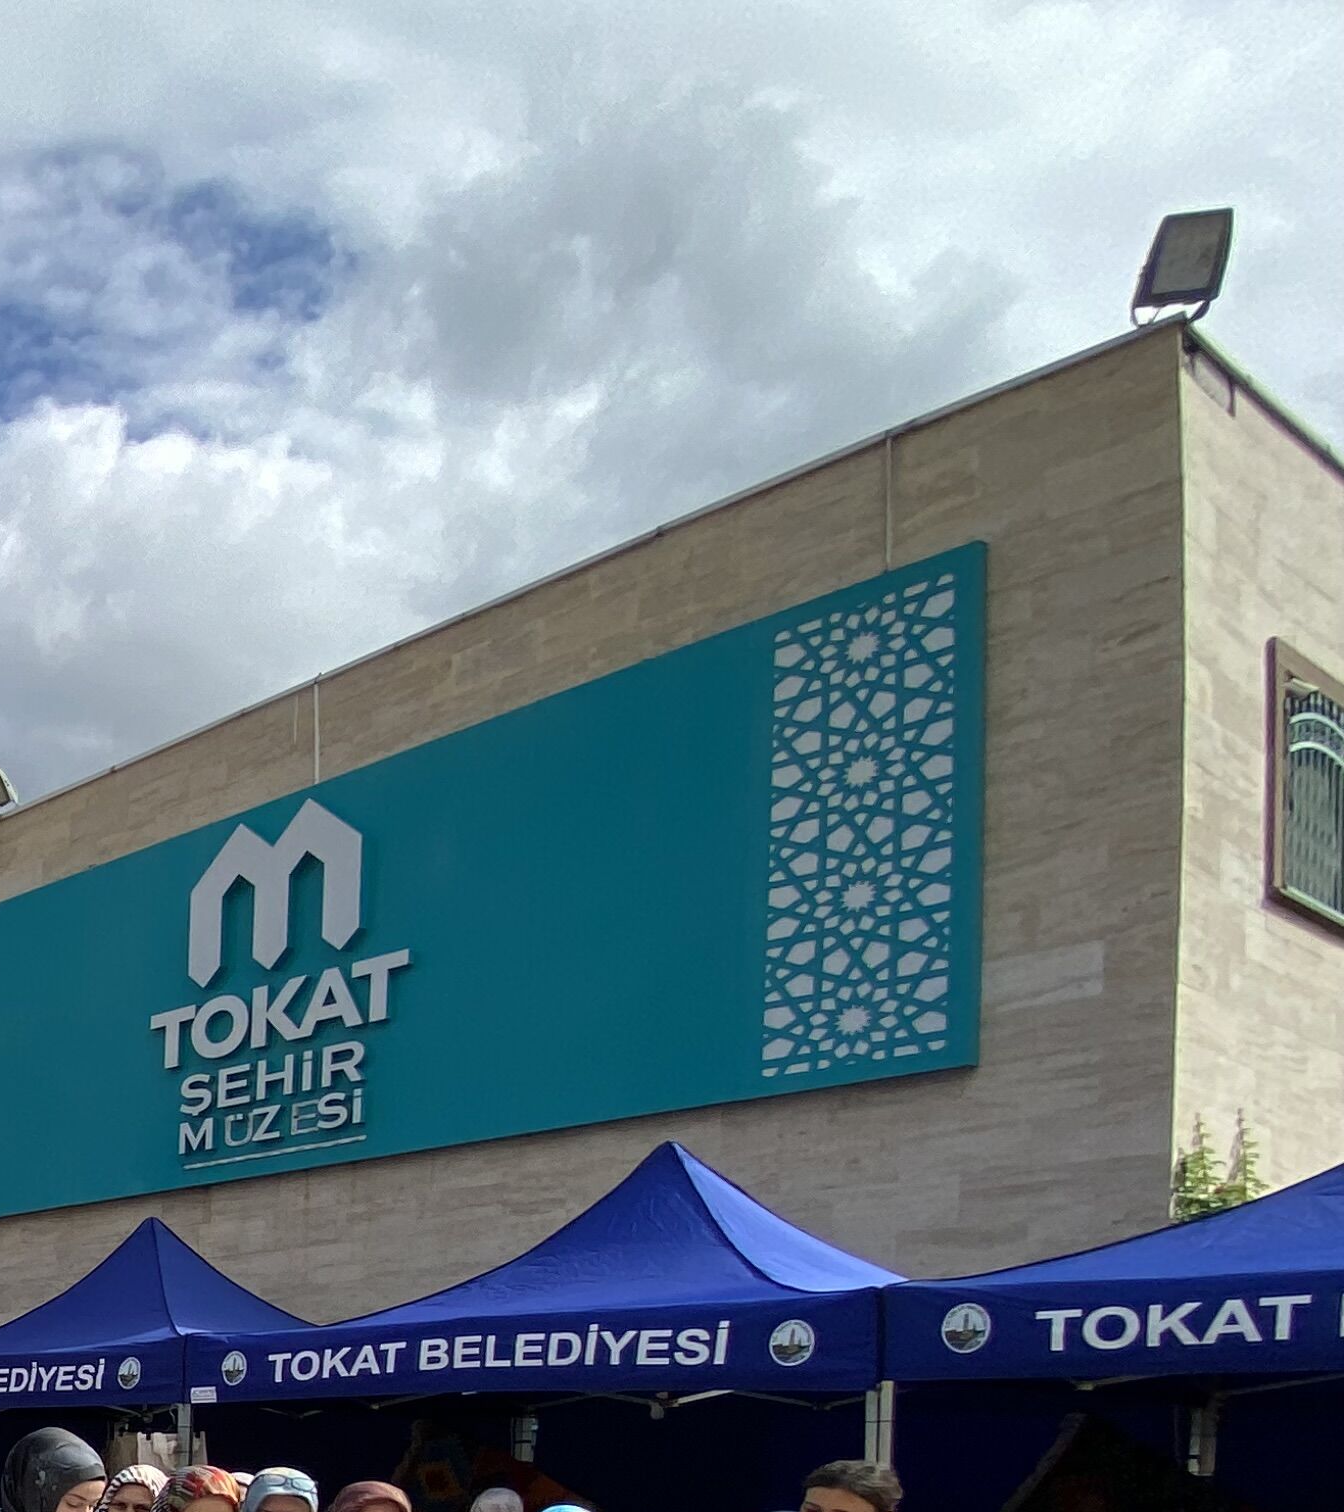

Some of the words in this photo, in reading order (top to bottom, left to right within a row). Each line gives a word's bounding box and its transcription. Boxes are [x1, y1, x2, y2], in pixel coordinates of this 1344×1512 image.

[150, 948, 410, 1070] TOKAT
[179, 1040, 365, 1117] ŞEHİR
[178, 1088, 364, 1155] MÜZESİ
[268, 1341, 406, 1383] TOKAT
[418, 1320, 730, 1371] BELEDİYESİ
[1035, 1294, 1312, 1352] TOKAT
